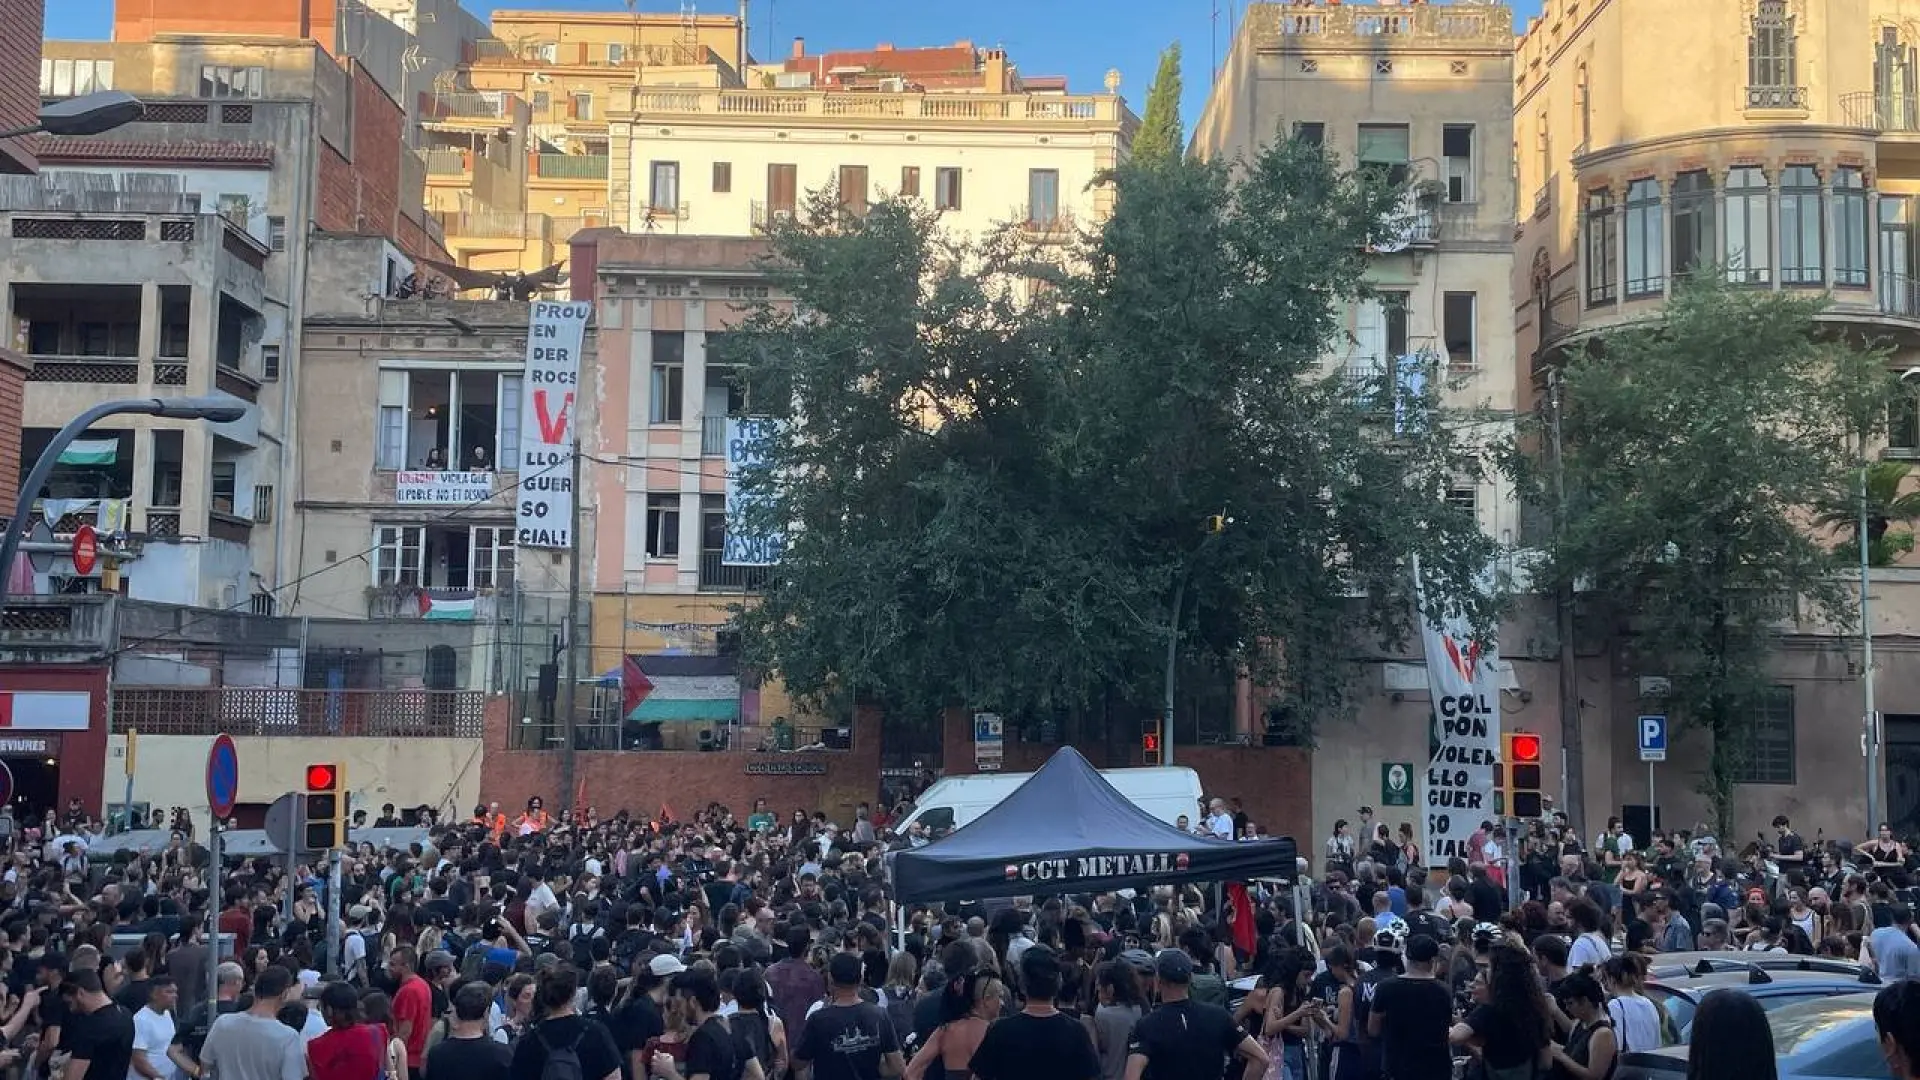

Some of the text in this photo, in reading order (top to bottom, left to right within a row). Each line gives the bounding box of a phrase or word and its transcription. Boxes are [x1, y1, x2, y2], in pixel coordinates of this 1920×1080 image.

[536, 304, 588, 319] PROU
[534, 323, 556, 338] EN
[534, 347, 568, 361] DER
[532, 369, 577, 384] ROCS
[524, 476, 571, 493] GUER
[436, 489, 449, 501] NO
[453, 489, 461, 501] ET
[520, 501, 549, 518] SO
[519, 528, 567, 546] CIAL!
[1643, 719, 1660, 746] P
[1428, 768, 1468, 787] LLO
[1428, 789, 1482, 809] GUER
[1429, 814, 1450, 834] SO
[1021, 853, 1174, 881] CGT METALL
